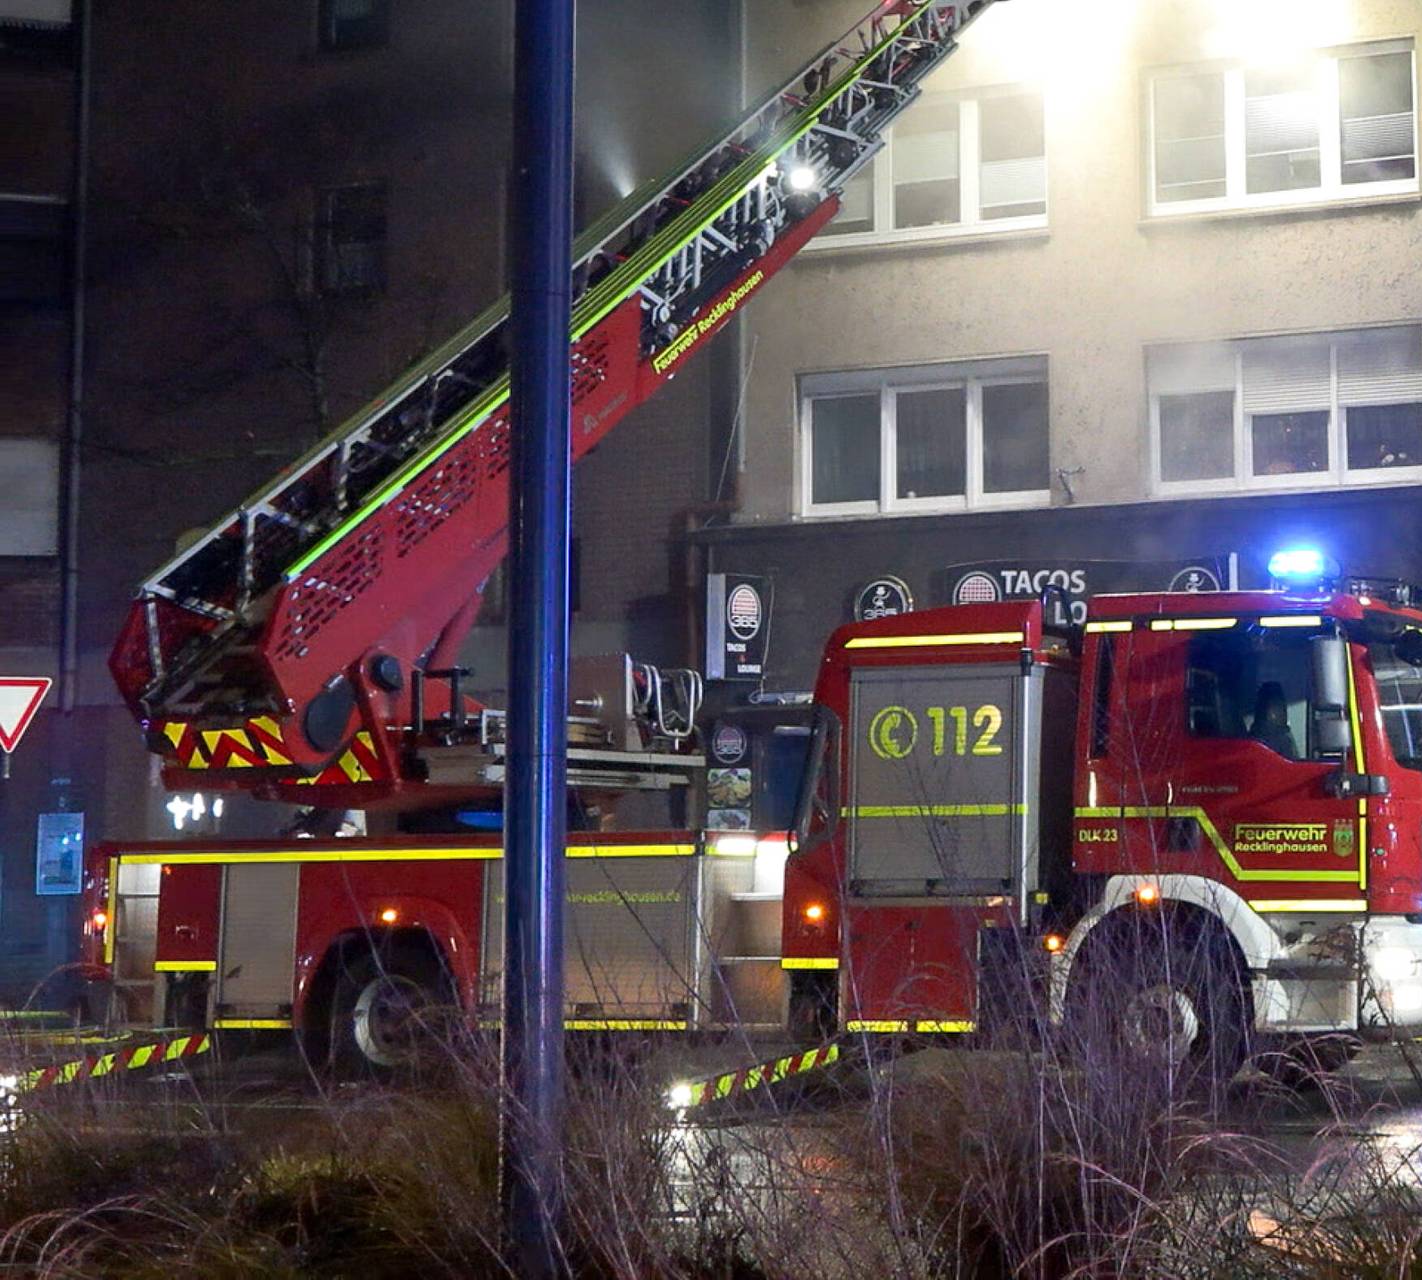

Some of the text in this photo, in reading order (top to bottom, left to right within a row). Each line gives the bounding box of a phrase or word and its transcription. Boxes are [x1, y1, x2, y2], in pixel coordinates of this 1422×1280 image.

[653, 270, 764, 374] Feuerwehr Recklinghausen
[1001, 569, 1086, 593] TACOS
[927, 704, 1002, 756] 112
[1235, 823, 1327, 841] Feuerwehr
[1235, 842, 1328, 854] Recklinghausen
